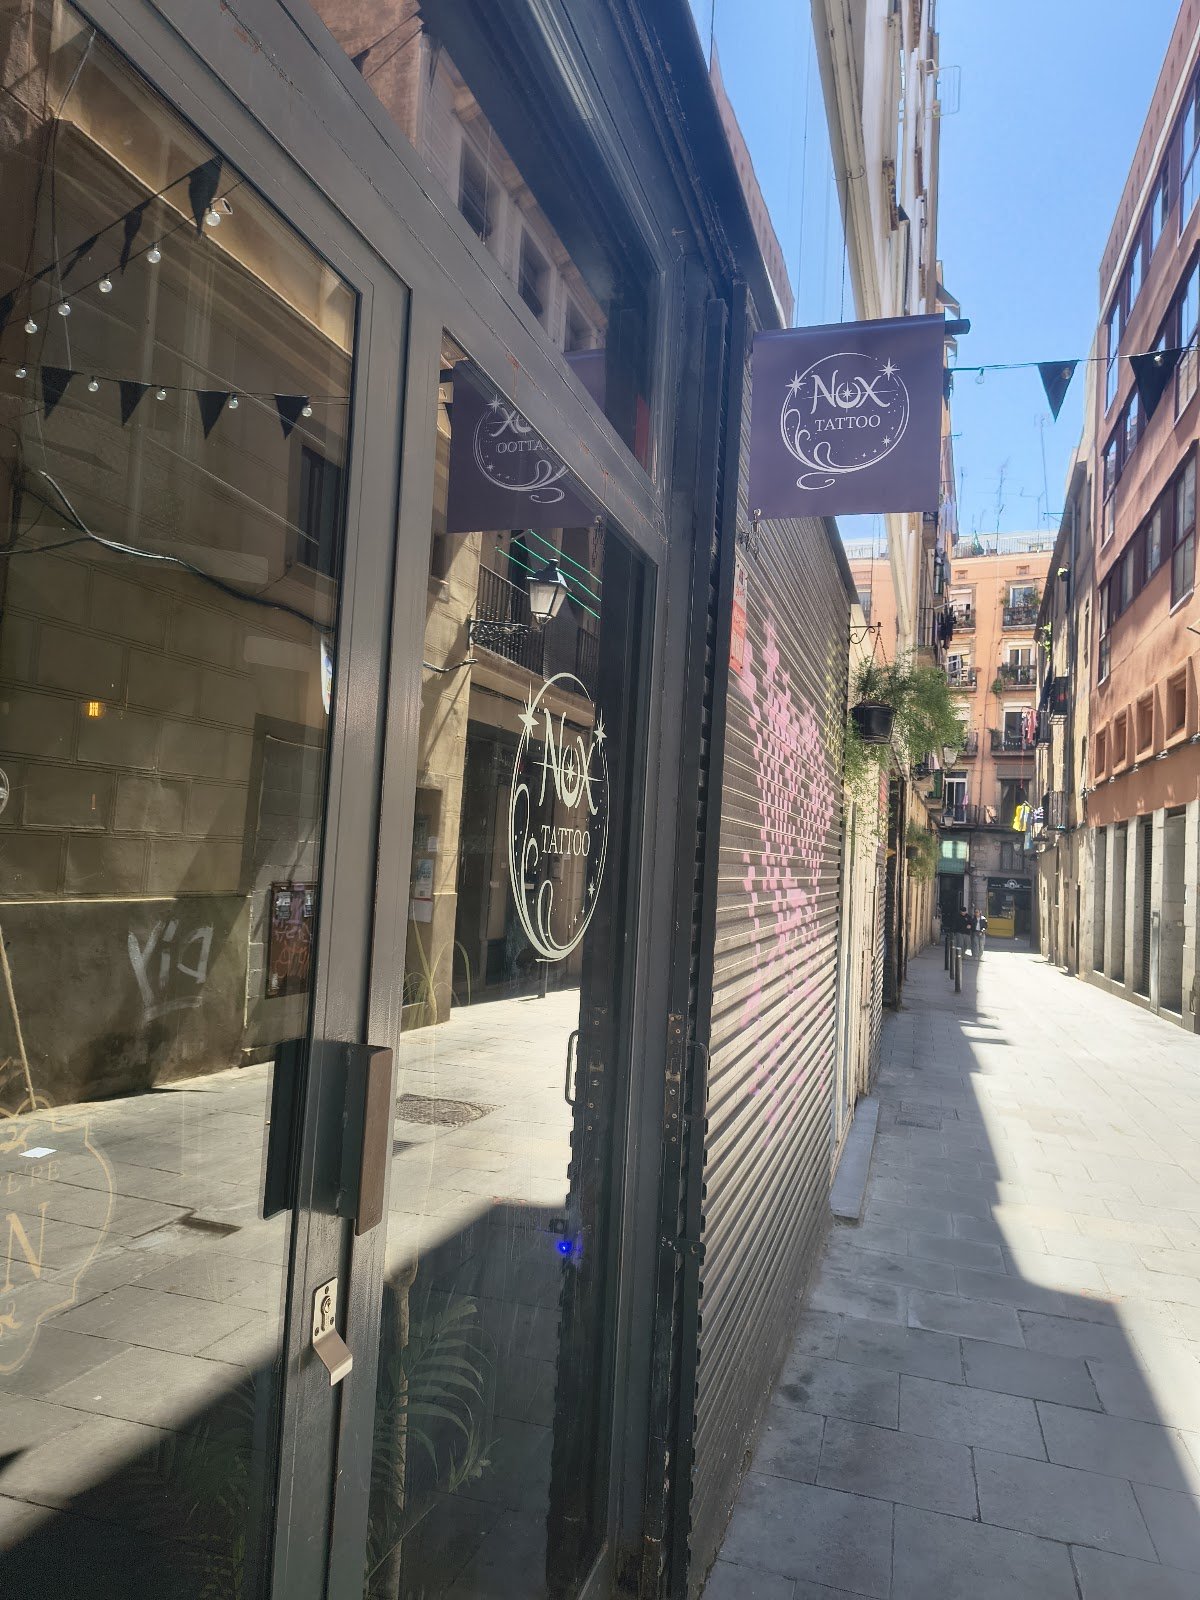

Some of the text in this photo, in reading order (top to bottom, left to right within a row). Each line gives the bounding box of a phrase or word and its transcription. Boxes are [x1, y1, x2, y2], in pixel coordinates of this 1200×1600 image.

[811, 369, 891, 414] NOX
[815, 414, 881, 432] TATTOO
[538, 707, 599, 815] NOX
[541, 824, 591, 857] TATTOO
